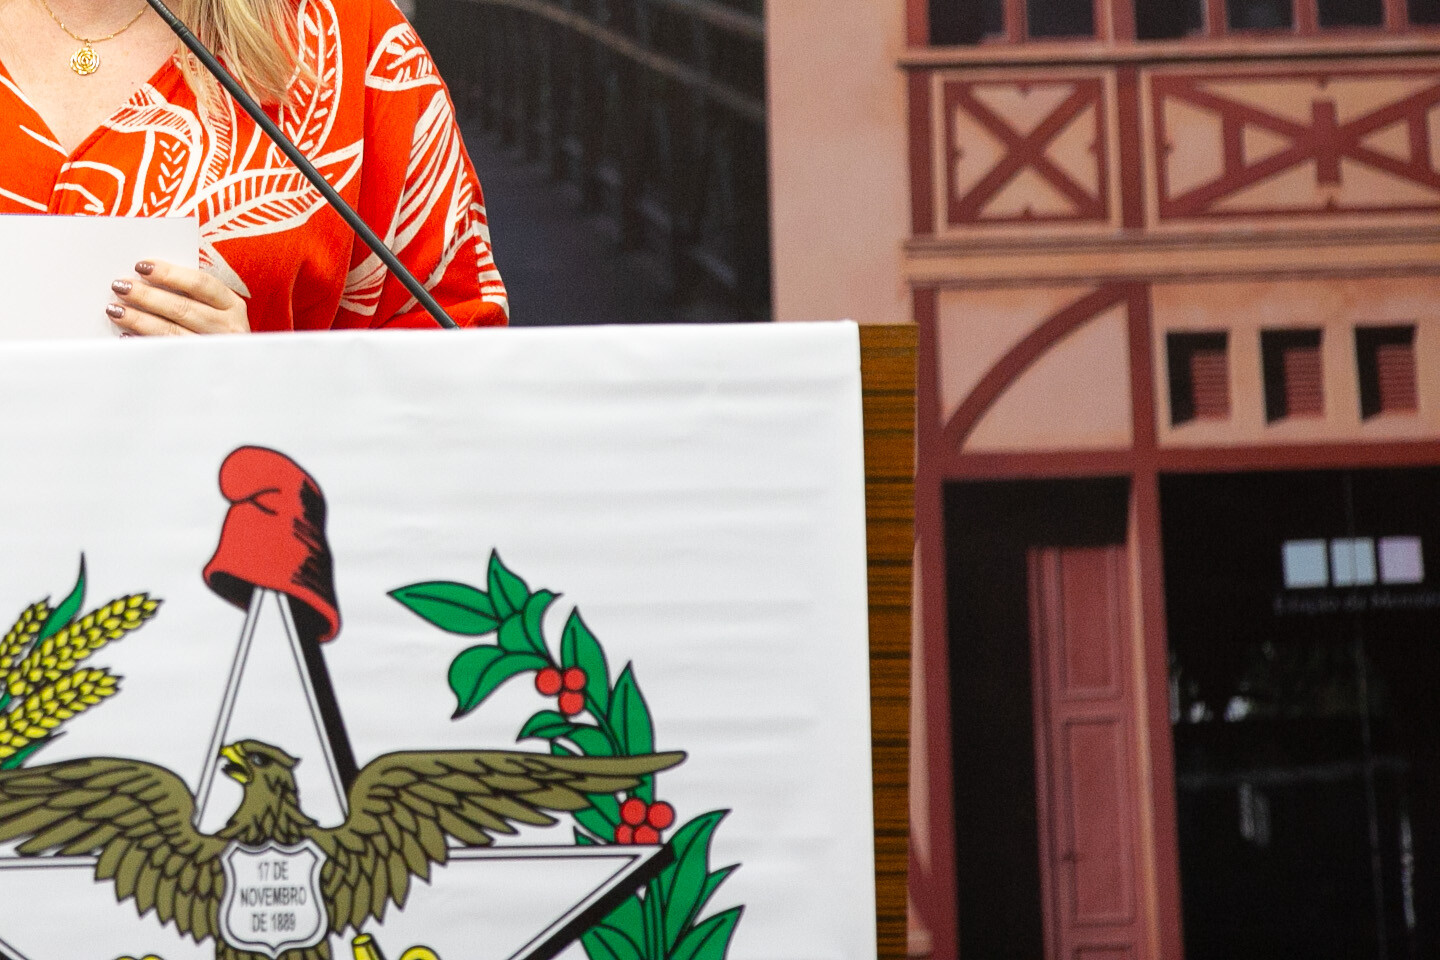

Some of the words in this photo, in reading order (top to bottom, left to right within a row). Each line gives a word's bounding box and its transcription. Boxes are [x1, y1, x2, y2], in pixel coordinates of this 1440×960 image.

[258, 861, 270, 881] 17
[274, 862, 289, 880] DE
[240, 886, 307, 907] NOVEMBRO
[252, 913, 268, 933] DE
[271, 912, 296, 932] 1889
